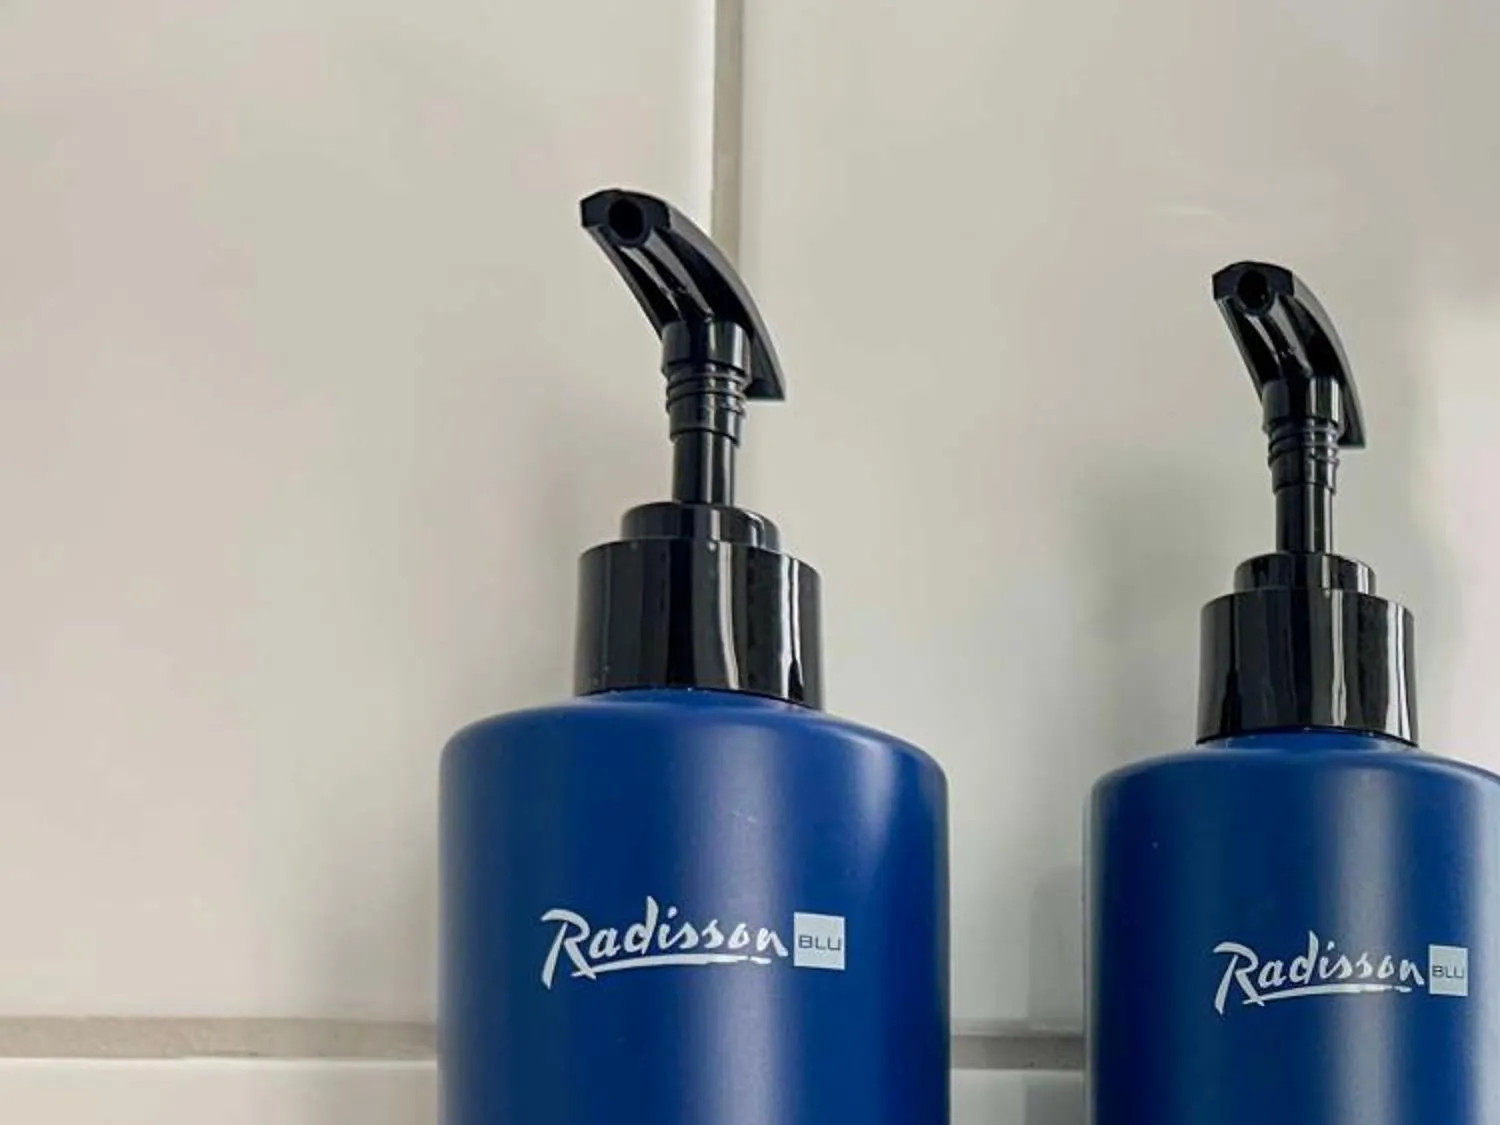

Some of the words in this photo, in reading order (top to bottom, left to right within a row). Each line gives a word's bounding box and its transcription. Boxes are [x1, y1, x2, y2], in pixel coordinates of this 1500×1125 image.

[540, 896, 789, 989] Radisson
[798, 934, 843, 953] BLU
[1213, 930, 1424, 1014] Radisson
